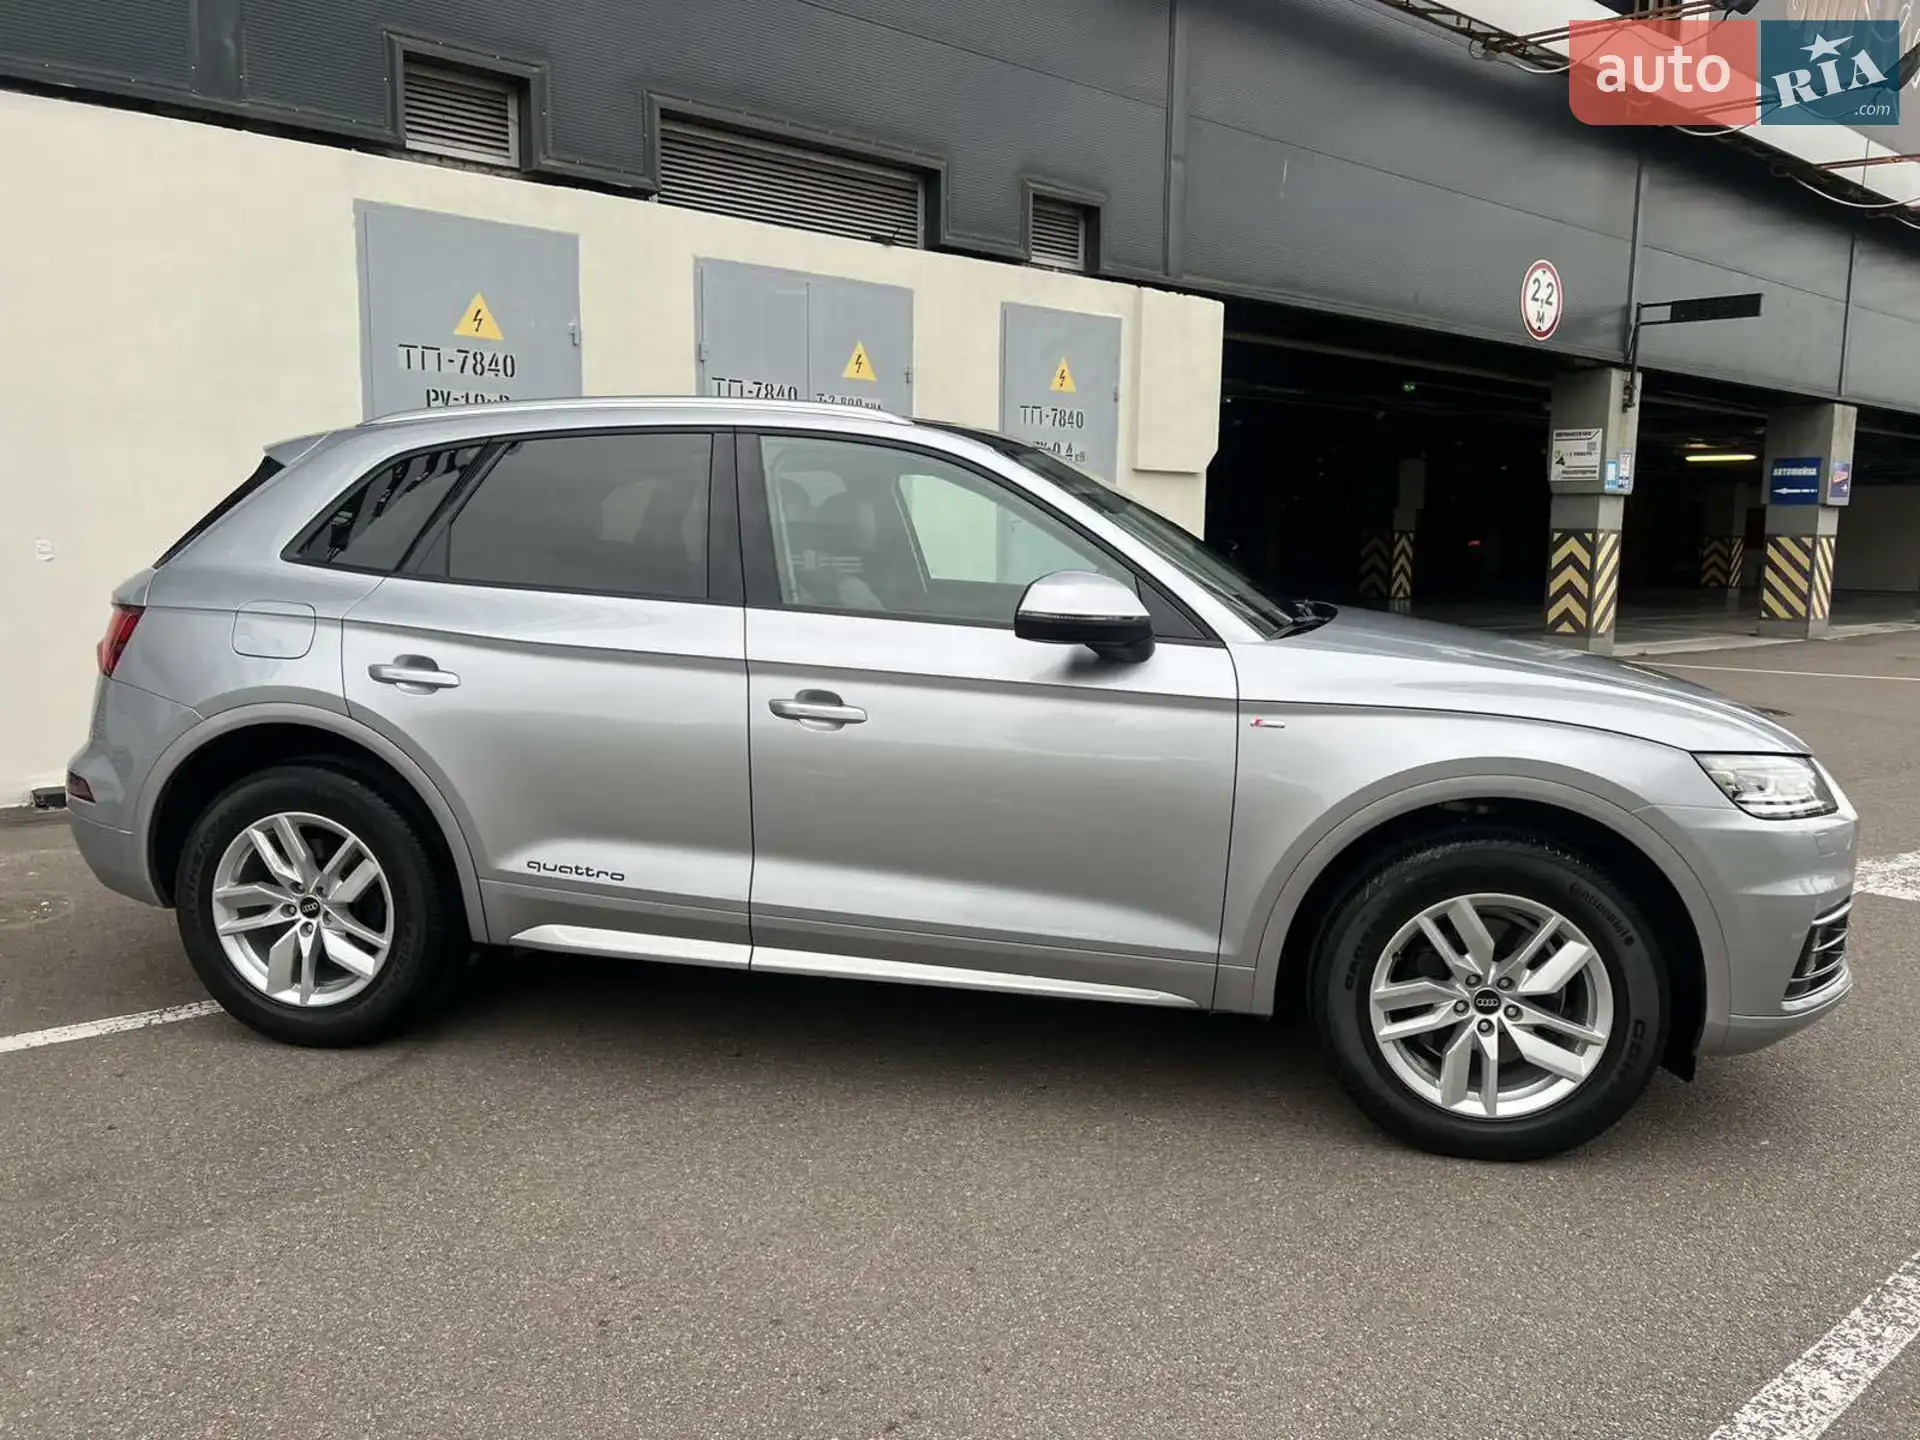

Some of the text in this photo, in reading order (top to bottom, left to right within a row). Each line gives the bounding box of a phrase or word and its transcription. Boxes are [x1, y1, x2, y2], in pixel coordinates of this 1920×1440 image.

[1531, 278, 1554, 307] 2,2
[398, 343, 516, 379] ТП-7840
[1020, 405, 1084, 429] ТП-7840
[526, 860, 625, 882] quattro
